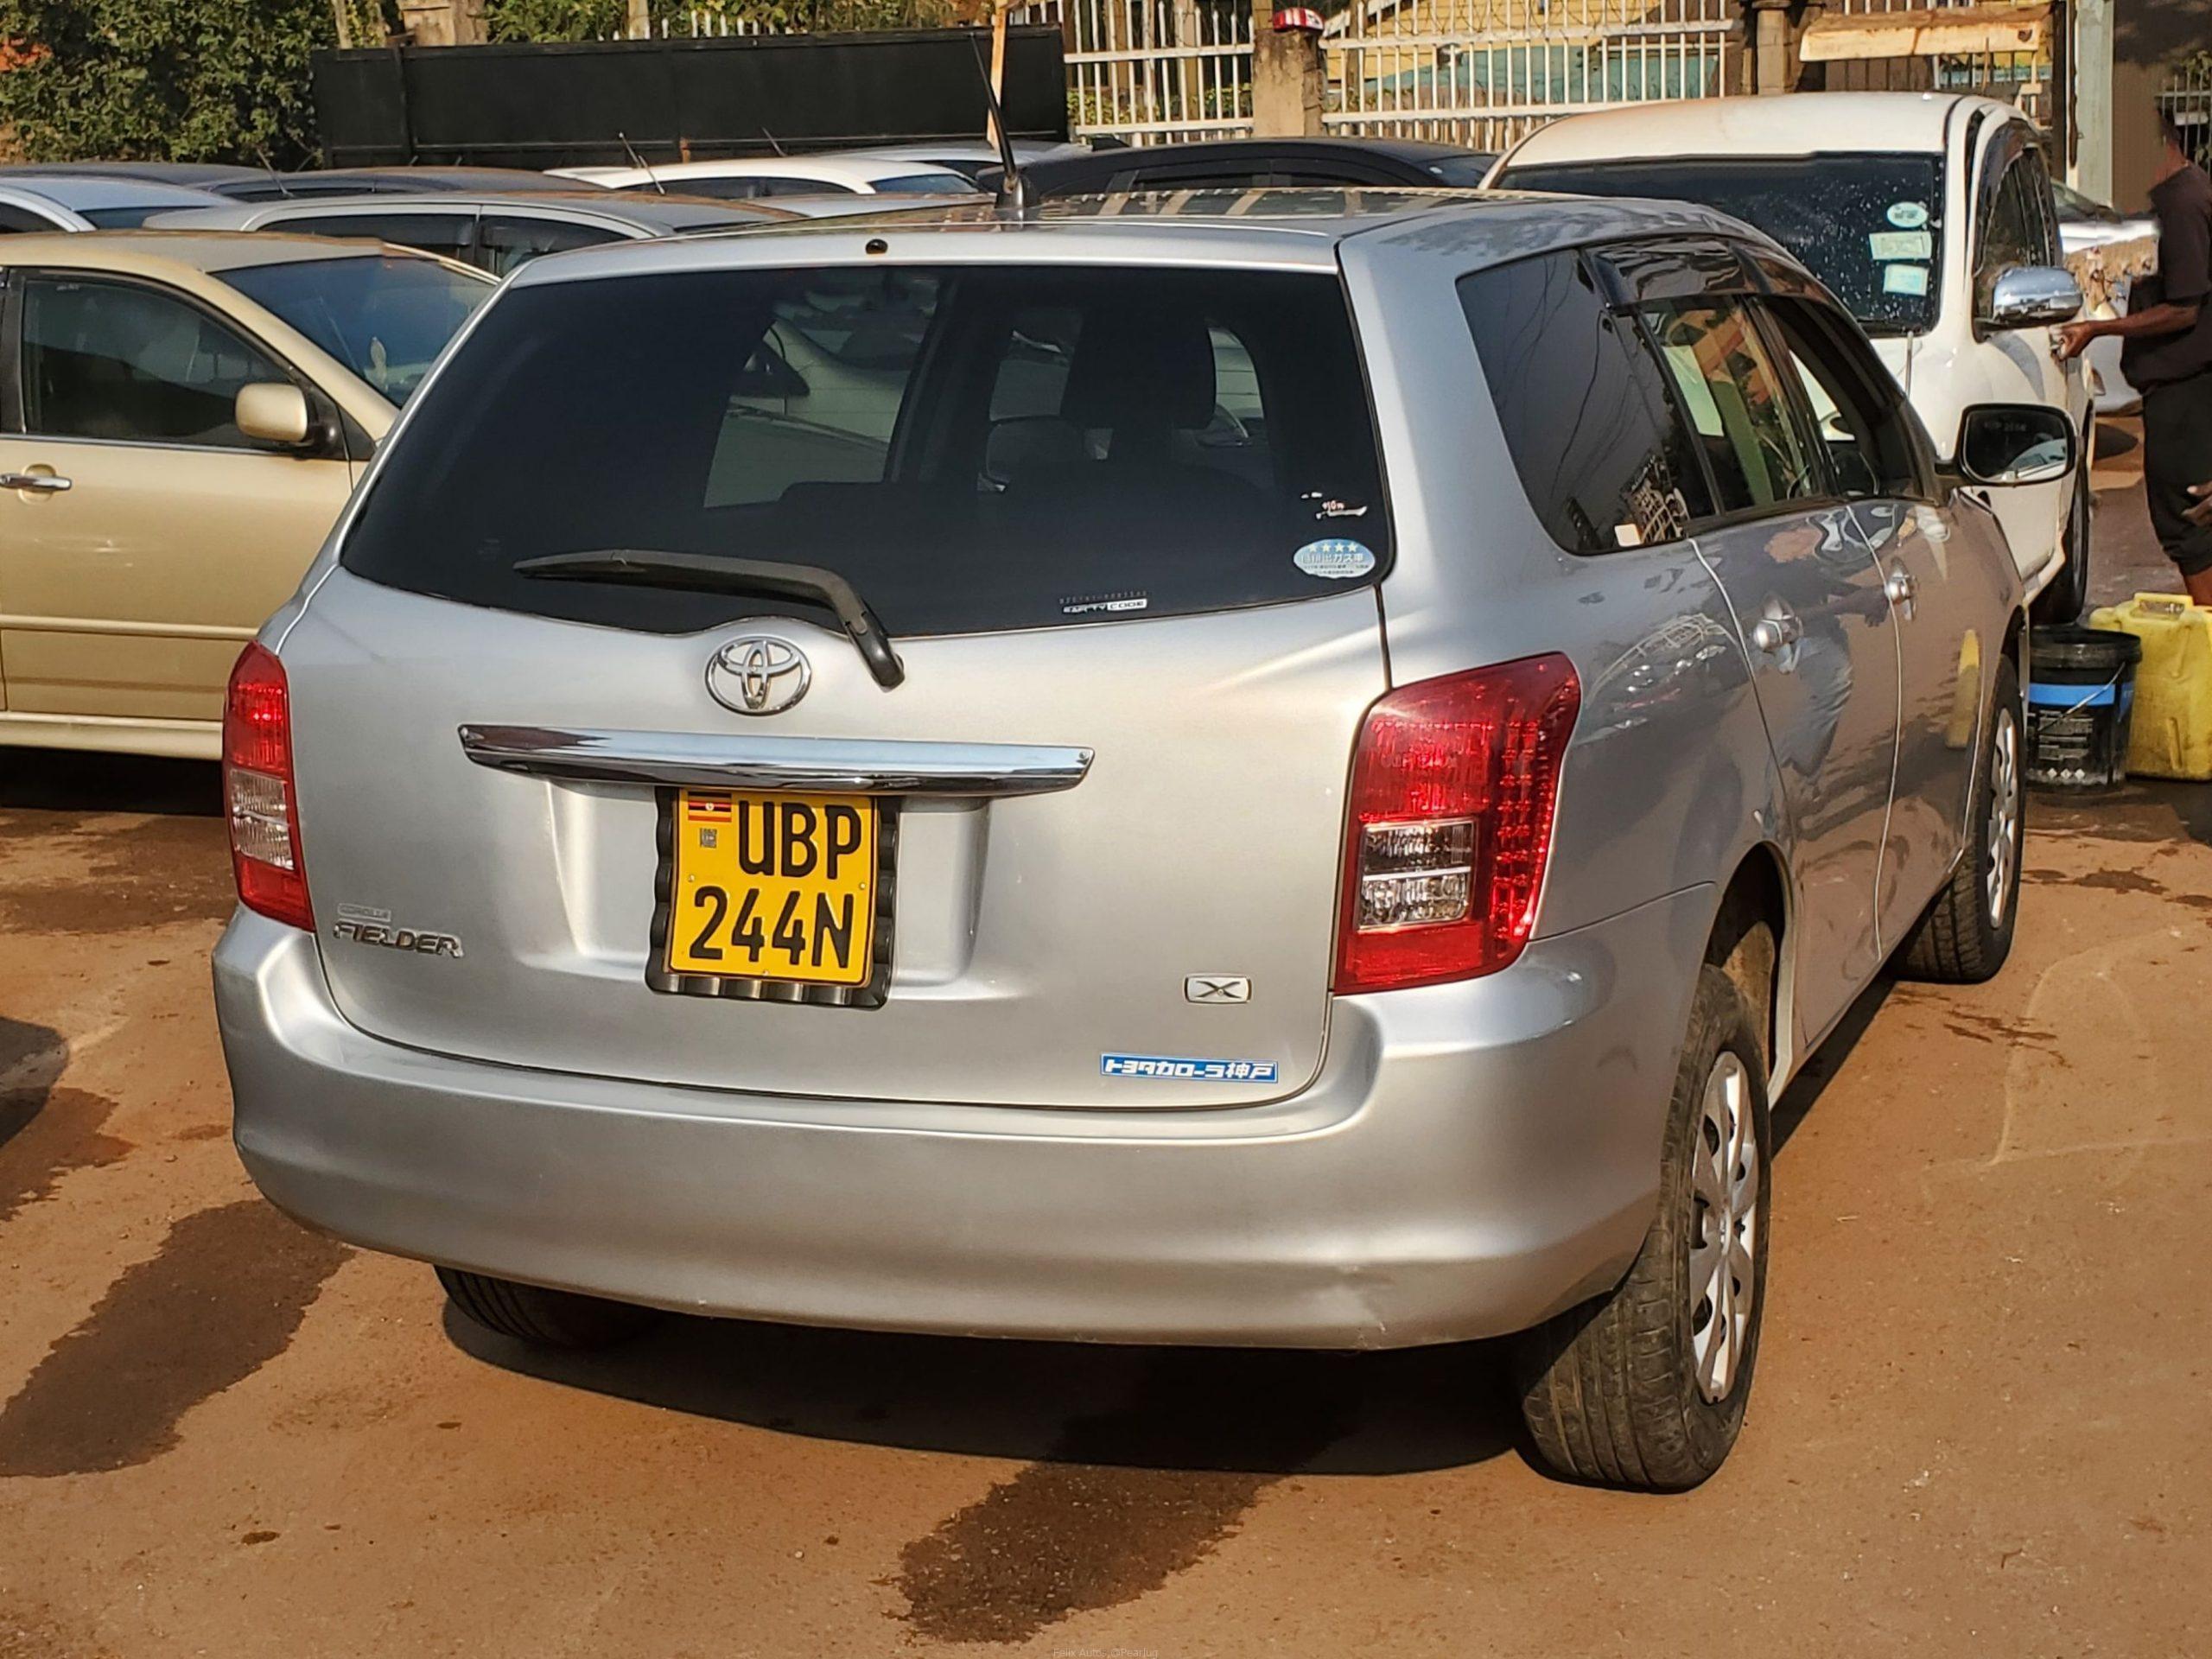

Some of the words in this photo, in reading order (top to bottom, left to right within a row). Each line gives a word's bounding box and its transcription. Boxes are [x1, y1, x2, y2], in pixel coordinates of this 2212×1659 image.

[739, 800, 862, 880] UBP
[333, 918, 463, 958] FIELDER
[690, 885, 855, 969] 244N
[1104, 1058, 1275, 1079] トヨタカローラ神戸
